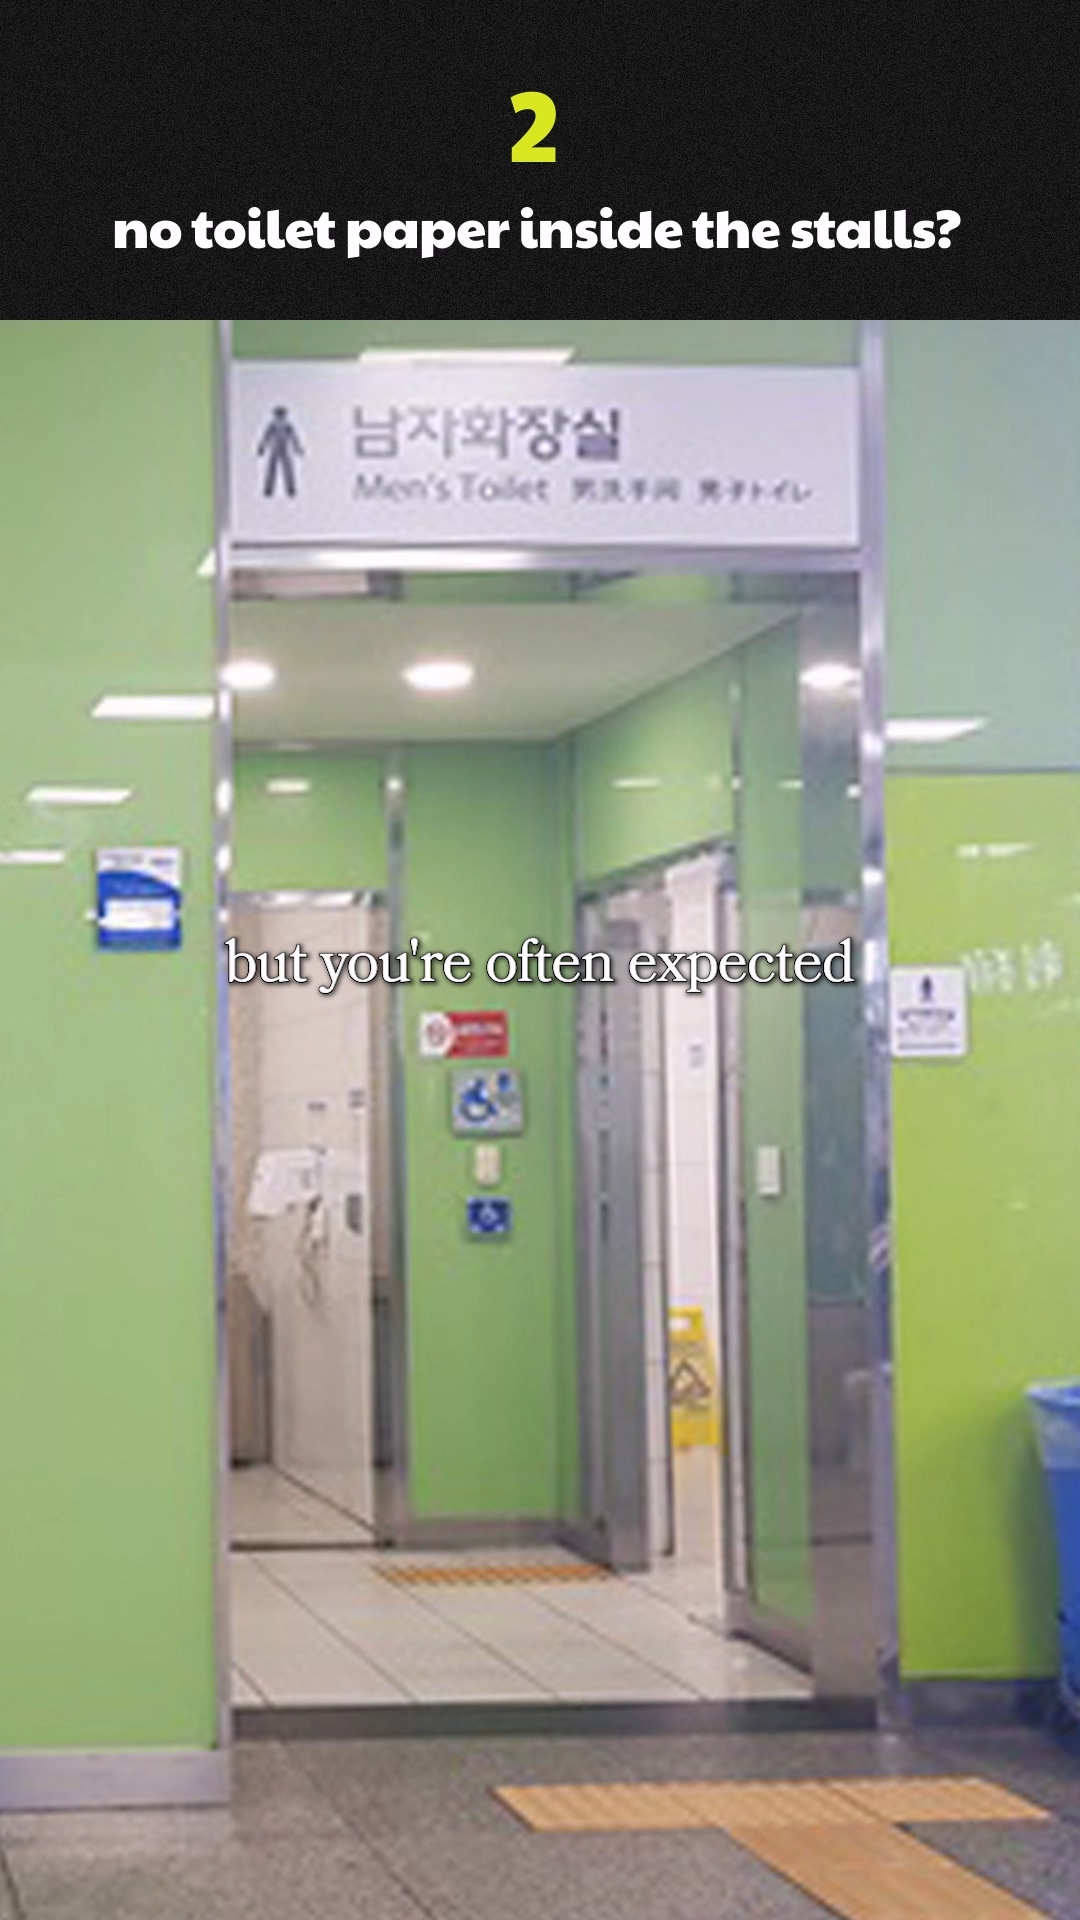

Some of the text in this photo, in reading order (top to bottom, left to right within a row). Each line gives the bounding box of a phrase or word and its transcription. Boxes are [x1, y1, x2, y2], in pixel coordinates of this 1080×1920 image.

[352, 406, 623, 463] 남자화장실
[353, 473, 549, 502] Men's Toilet
